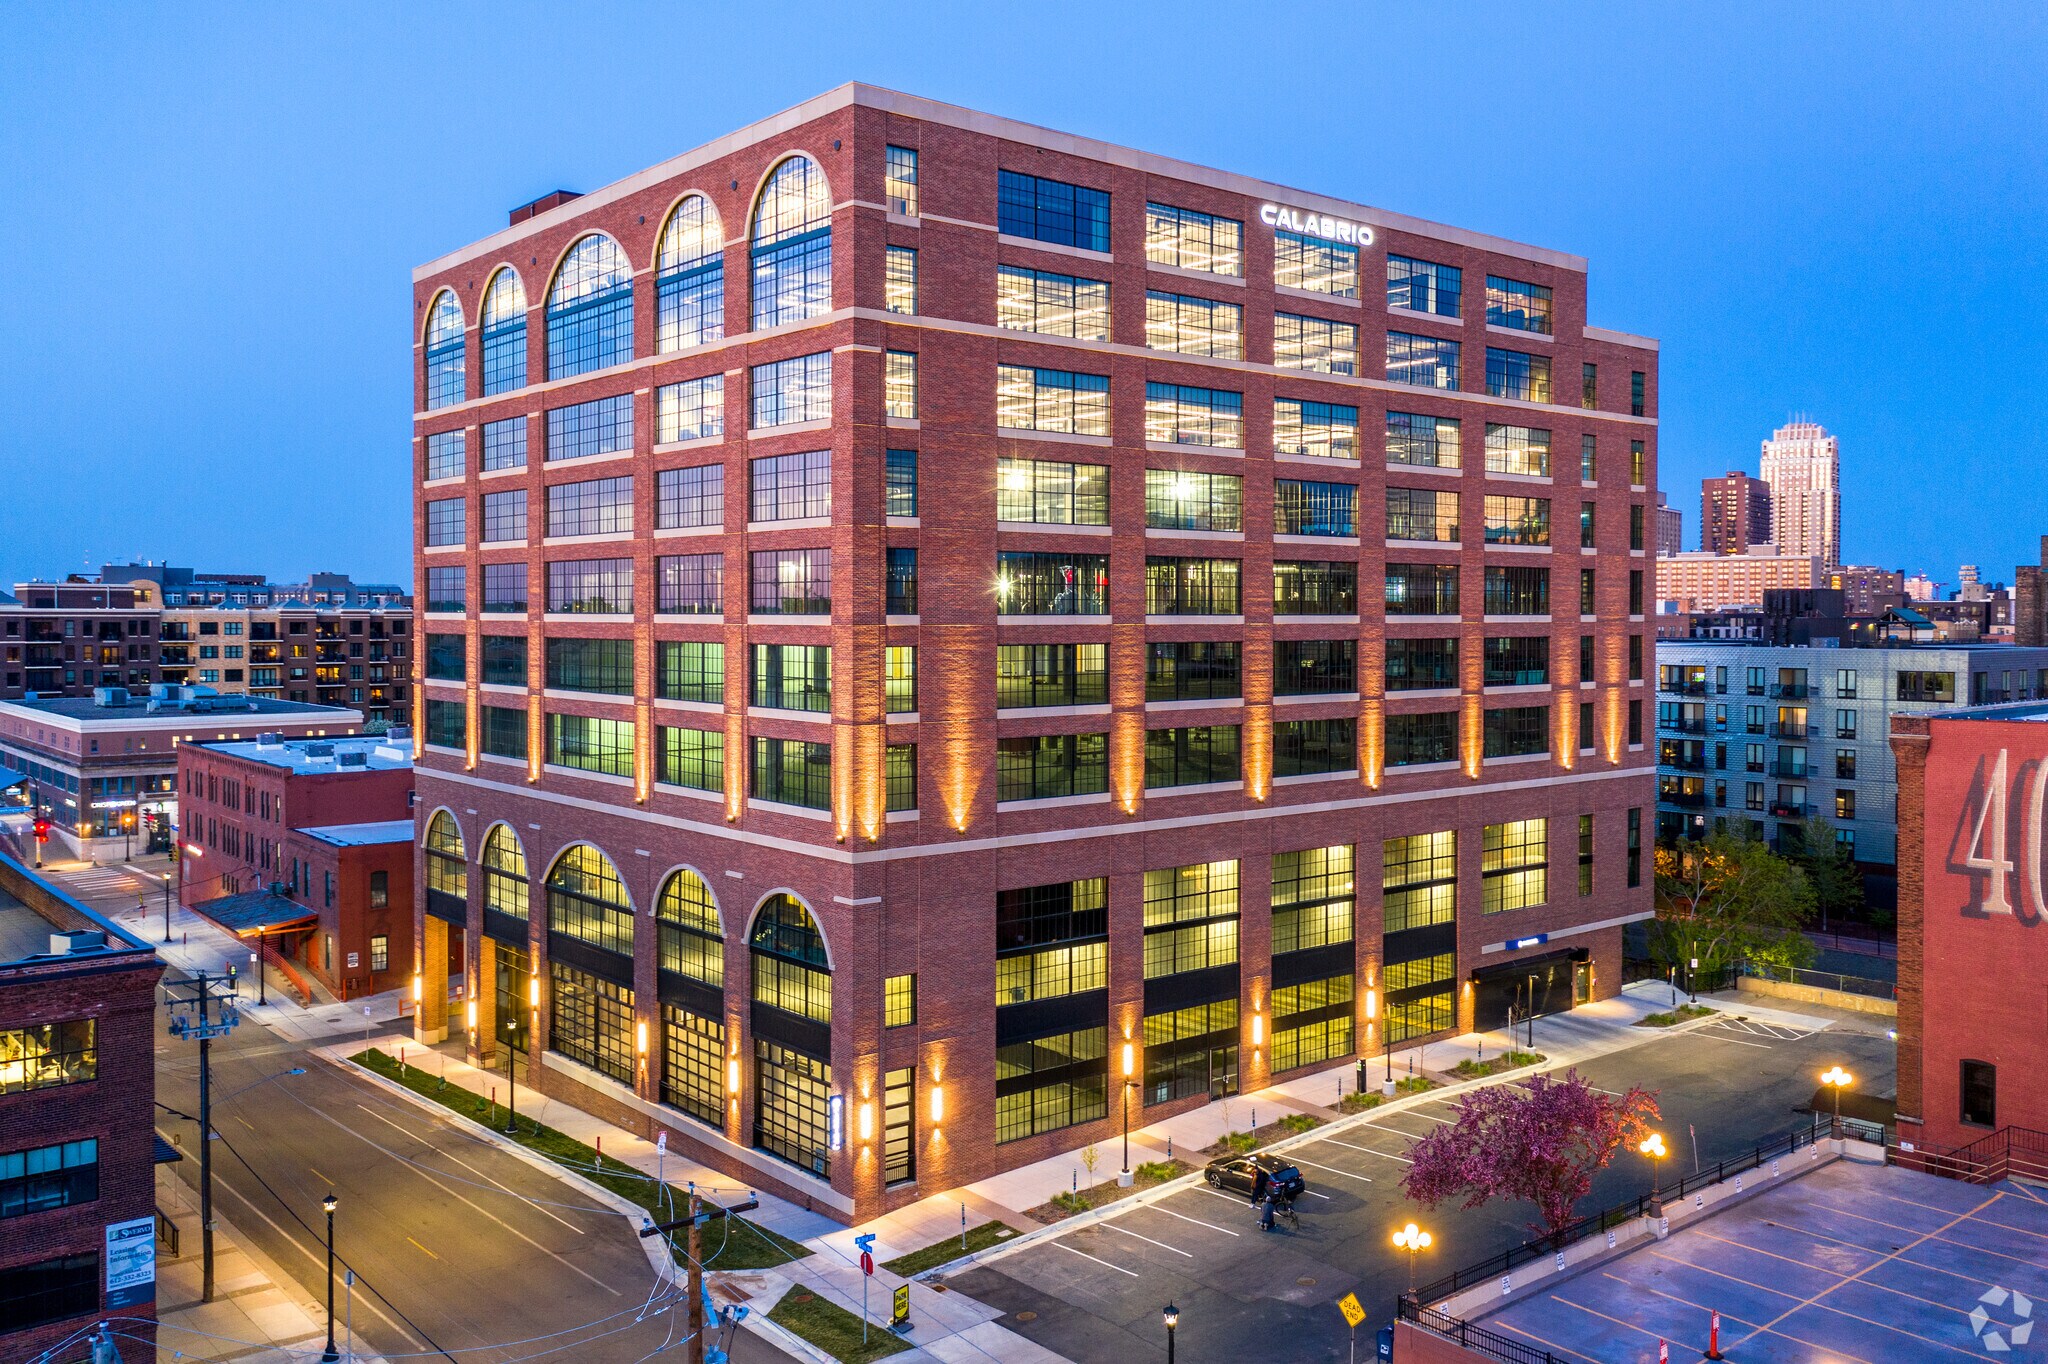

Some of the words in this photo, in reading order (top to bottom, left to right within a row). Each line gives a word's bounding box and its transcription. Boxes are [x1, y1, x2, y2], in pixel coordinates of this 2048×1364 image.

[1260, 204, 1373, 246] CALABRIO
[121, 1225, 151, 1238] SWERVO
[110, 1246, 137, 1256] Leasing
[110, 1250, 152, 1263] Information
[896, 1300, 907, 1312] HERE
[1343, 1301, 1360, 1313] DEAD
[1346, 1310, 1358, 1320] END
